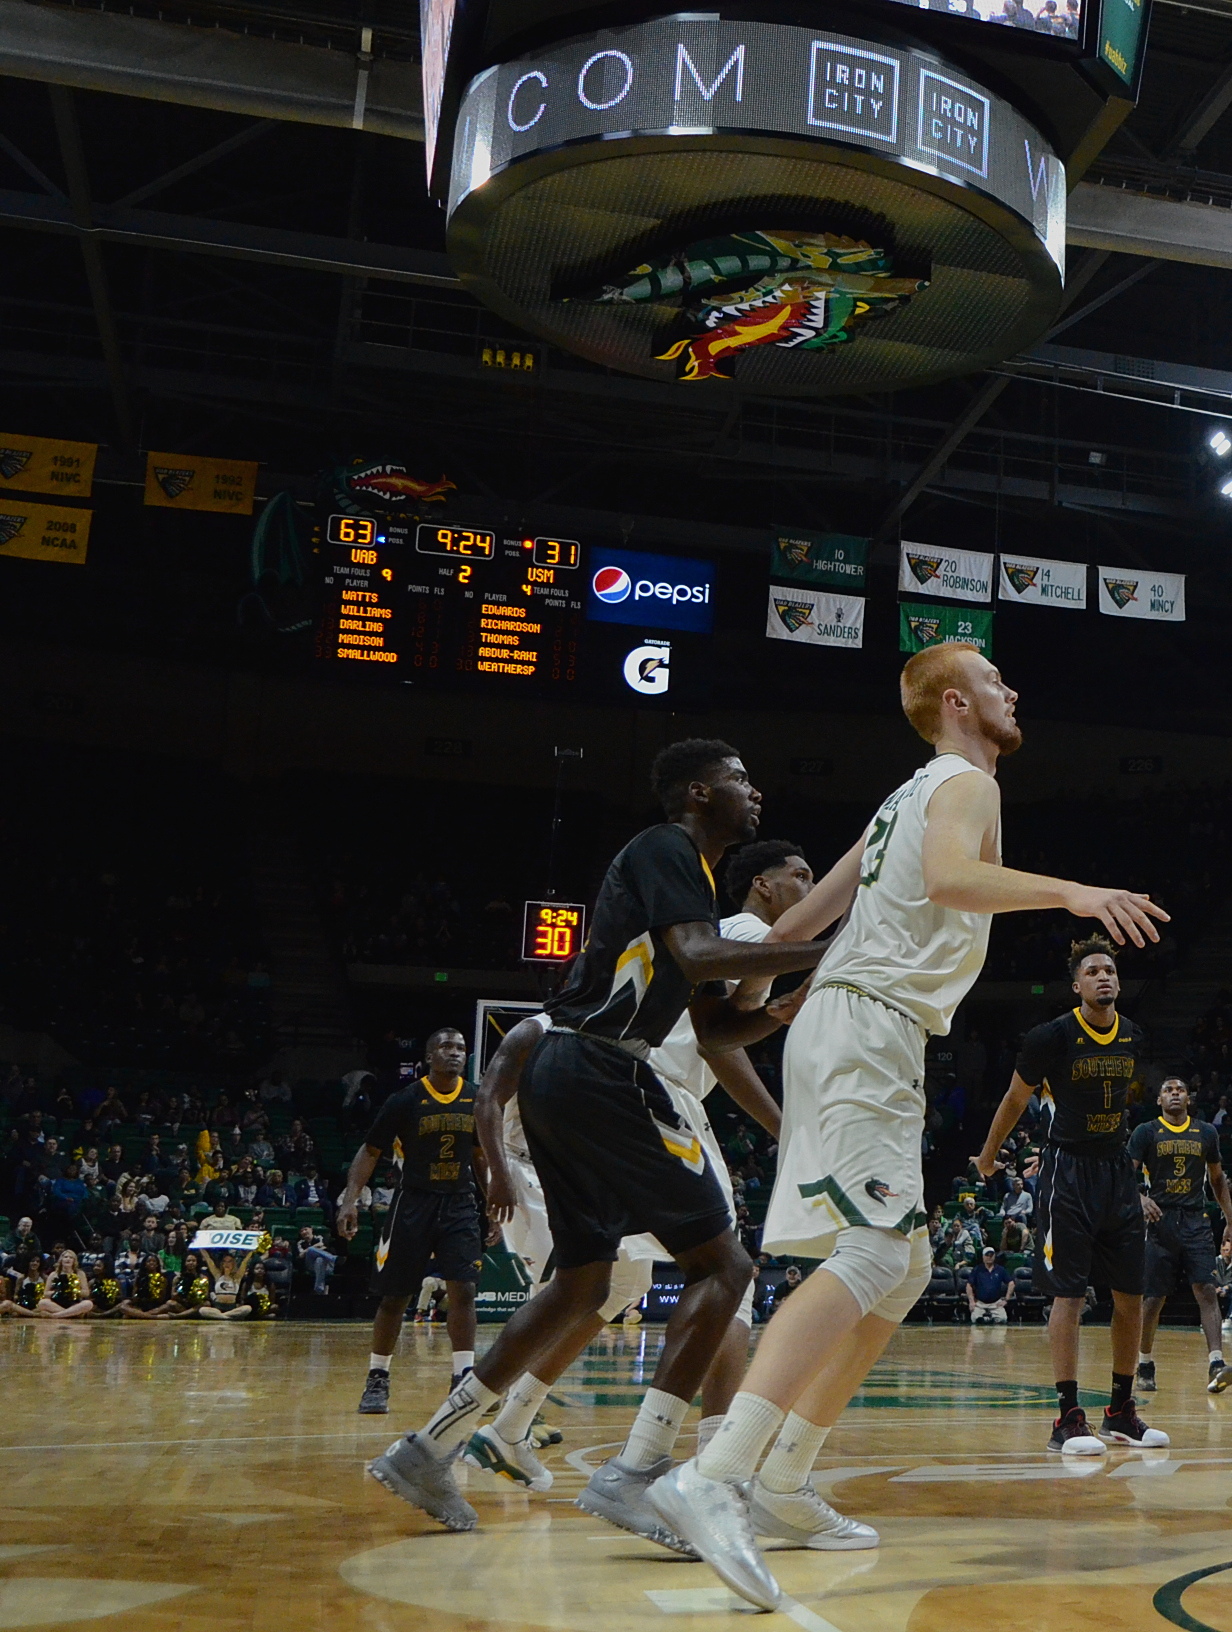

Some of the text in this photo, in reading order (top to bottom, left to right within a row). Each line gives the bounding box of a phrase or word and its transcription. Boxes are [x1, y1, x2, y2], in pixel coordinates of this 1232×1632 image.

[826, 62, 884, 94] IRON
[825, 88, 883, 119] CITY
[932, 92, 979, 130] IRON
[932, 119, 978, 154] CITY
[52, 456, 80, 468] 1991
[51, 471, 80, 483] NIVC
[214, 490, 242, 501] NIVC
[46, 520, 76, 534] 2008
[339, 518, 372, 544] 63
[388, 526, 408, 534] BONUS
[41, 536, 76, 550] NCAA
[437, 529, 491, 555] 9:24
[503, 539, 522, 547] BONUS
[351, 548, 378, 565] UAB
[546, 542, 576, 564] 31
[834, 549, 844, 560] 10
[333, 566, 394, 582] TEAM FOULS 9
[813, 560, 864, 576] HIGHTOWER
[944, 560, 956, 573] 20
[438, 565, 472, 584] HALF 2
[527, 567, 555, 584] USM
[1041, 568, 1050, 582] 14
[324, 576, 445, 596] NO PLAYER POINTS FLS
[521, 584, 569, 598] 4 TEAM FOULS
[942, 574, 988, 593] ROBINSON
[1151, 584, 1164, 598] 40
[342, 590, 378, 603] WATTS
[634, 580, 710, 605] pepsi
[1041, 584, 1084, 600] MITCHELL
[484, 592, 507, 602] PLAYER
[545, 598, 566, 608] POINTS
[570, 601, 582, 610] FLS
[1150, 599, 1175, 614] MINCY
[341, 605, 392, 619] WILLIAMS
[482, 604, 526, 618] EDWARDS
[339, 618, 384, 632] DARLING
[480, 618, 541, 634] RICHARDSON
[817, 623, 860, 639] SANDERS
[958, 622, 972, 634] 23
[338, 633, 384, 646] MADISON
[480, 633, 520, 646] THOMAS
[644, 638, 670, 646] GATORADE
[943, 635, 986, 648] JACKSON
[337, 648, 398, 662] SMALLWOOD
[478, 647, 538, 662] ABDUR-RAHI
[478, 661, 536, 675] WEATHERSP
[540, 908, 578, 926] 9:24
[535, 926, 571, 956] 30
[937, 1052, 952, 1062] 120
[1103, 1080, 1112, 1109] 1
[440, 1134, 456, 1159] 2
[1174, 1156, 1186, 1176] 3
[1166, 1178, 1192, 1194] MISS
[497, 1292, 531, 1302] MEDI
